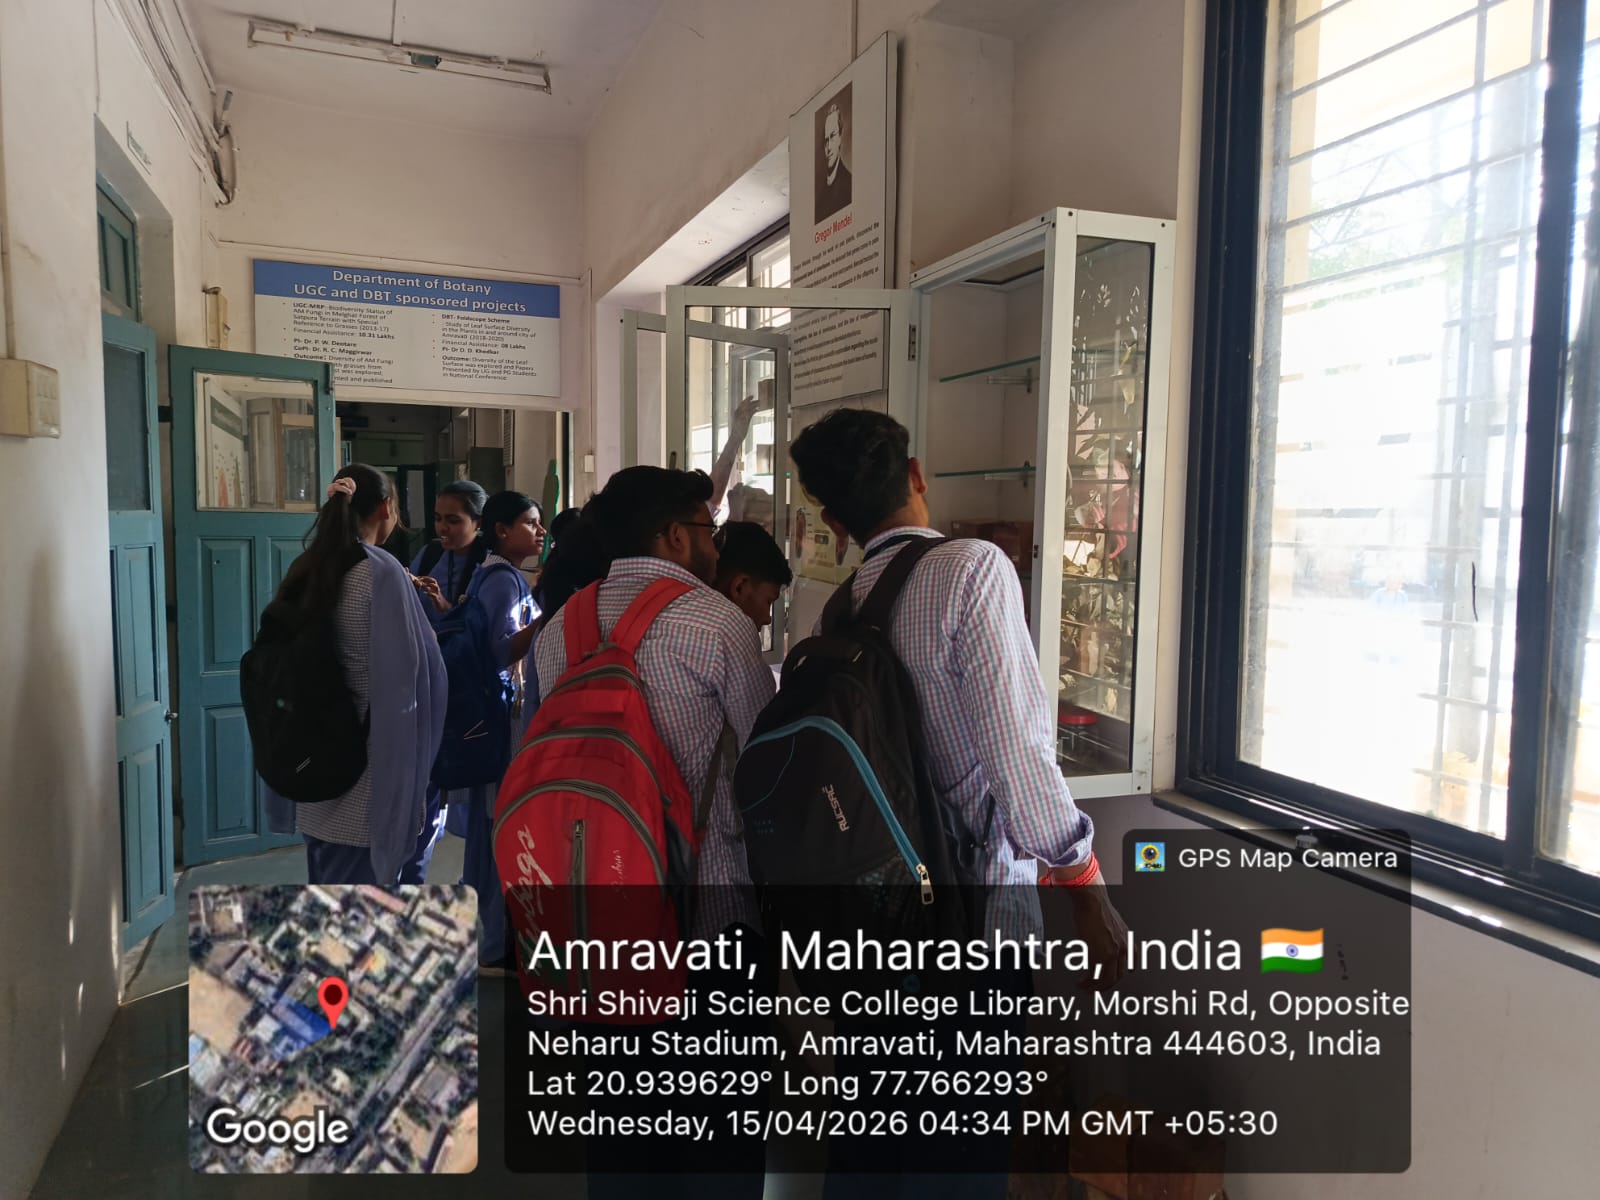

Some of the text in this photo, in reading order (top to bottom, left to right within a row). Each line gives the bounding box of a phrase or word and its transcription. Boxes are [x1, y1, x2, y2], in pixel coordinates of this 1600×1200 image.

[815, 212, 853, 244] Gregor Mendel
[333, 270, 492, 295] Department of Botany
[294, 284, 526, 312] UGC and DBT sponsored projects
[328, 305, 364, 313] Biodiversity
[328, 355, 355, 363] Diversity
